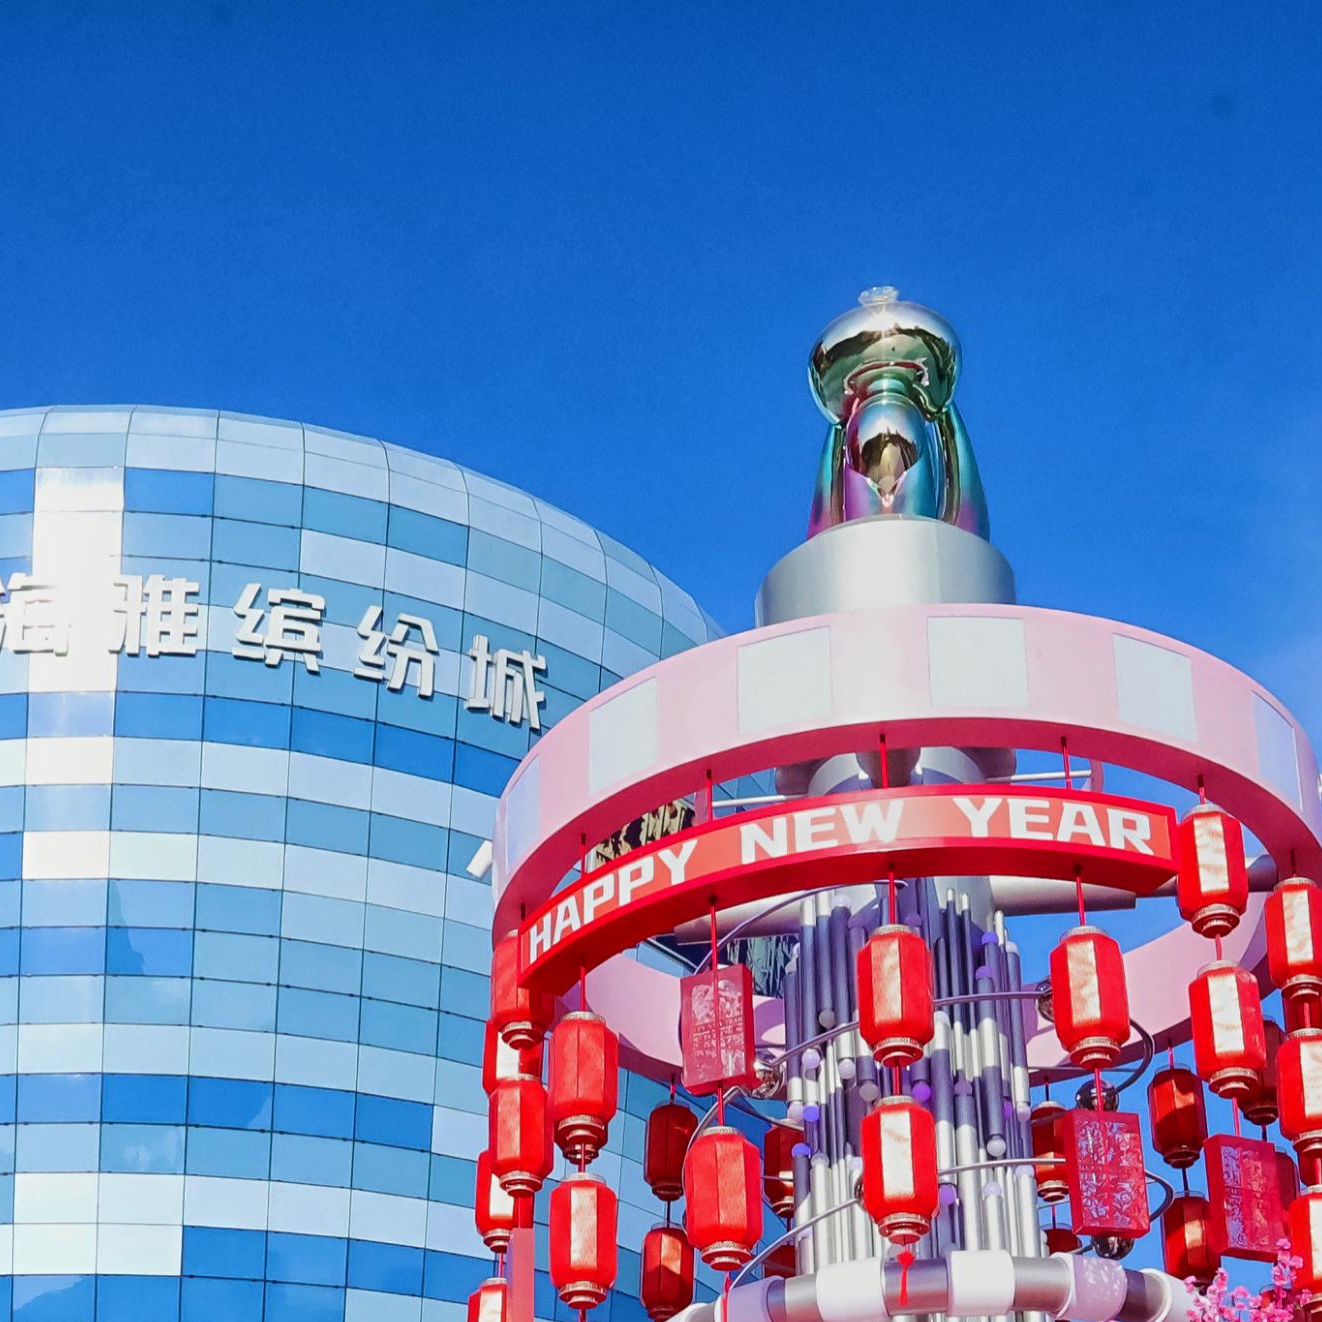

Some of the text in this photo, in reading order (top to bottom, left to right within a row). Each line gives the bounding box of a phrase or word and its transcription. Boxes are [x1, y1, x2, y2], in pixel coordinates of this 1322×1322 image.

[529, 797, 1155, 962] HAPPY NEW YEAR
